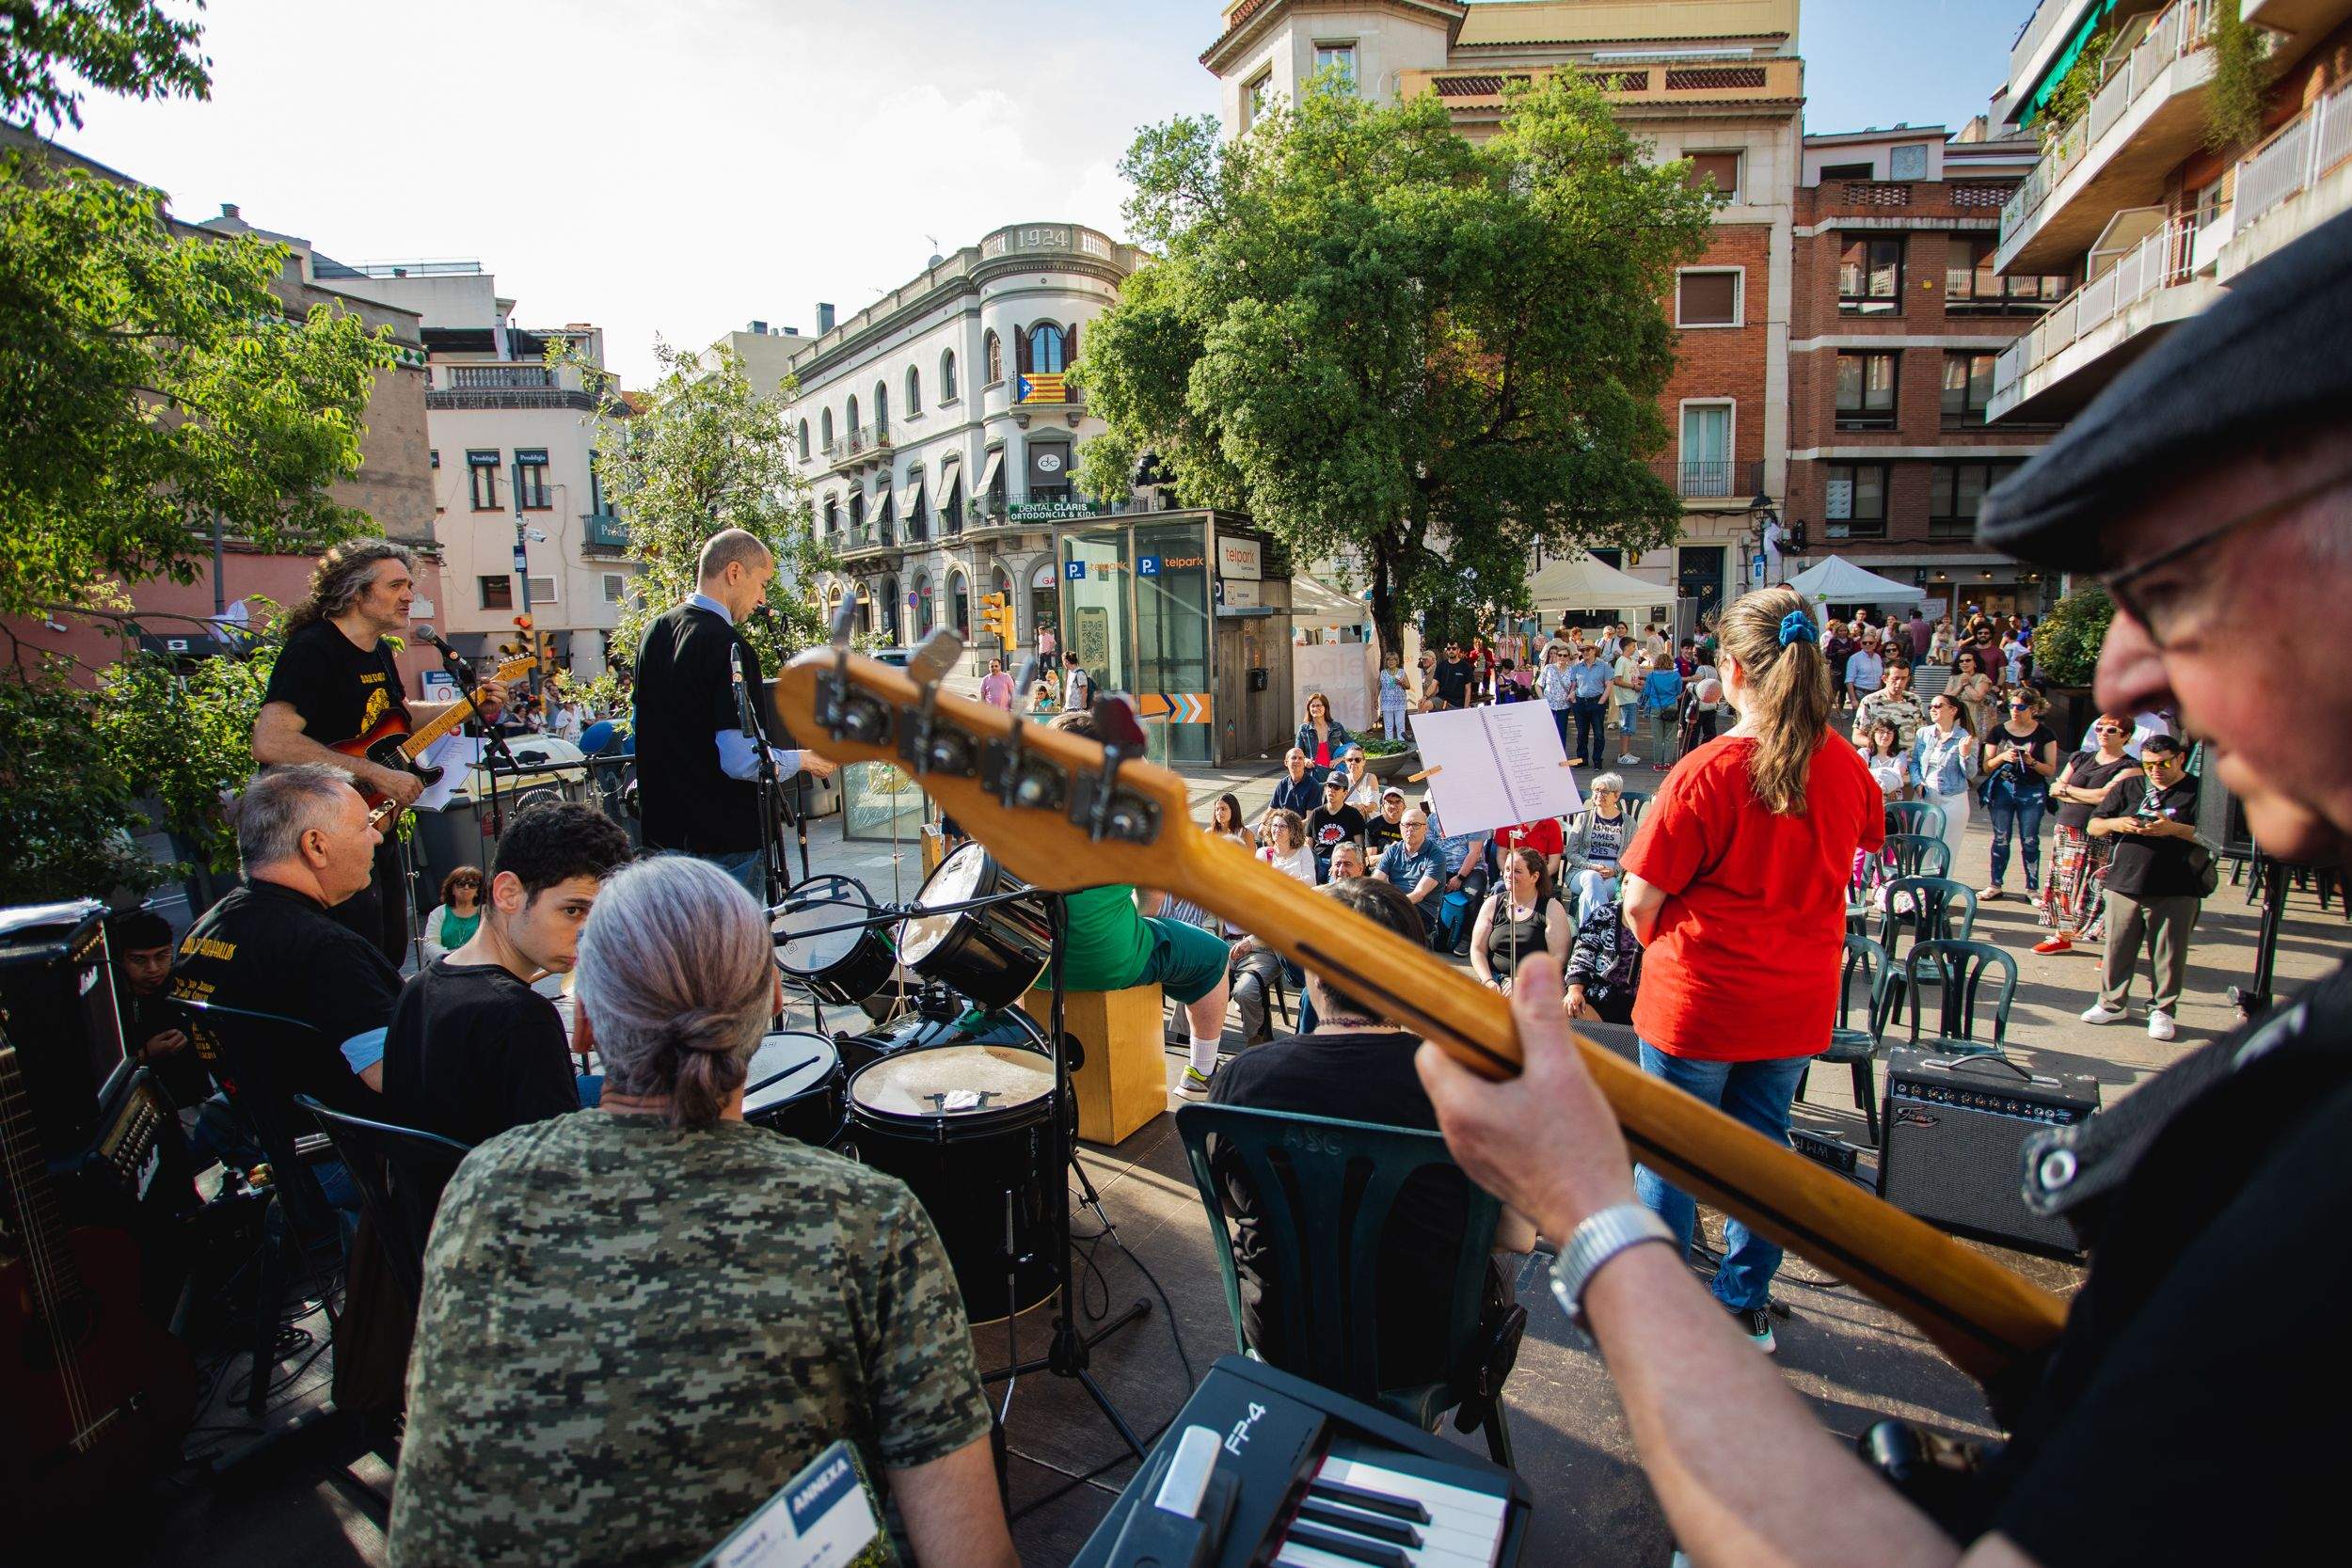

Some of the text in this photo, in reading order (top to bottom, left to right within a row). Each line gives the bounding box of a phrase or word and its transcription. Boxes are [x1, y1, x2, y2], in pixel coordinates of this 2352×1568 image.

[1019, 229, 1069, 247] 1924
[1010, 511, 1068, 520] ORTODONCIA
[1019, 504, 1052, 513] DENTAL
[1165, 557, 1204, 569] telpark
[1226, 546, 1255, 566] telpark
[1069, 563, 1078, 578] P
[1142, 559, 1152, 573] P
[1893, 1106, 1940, 1128] Fame
[1225, 1401, 1266, 1456] FP-4
[792, 1457, 850, 1515] ANNEXA
